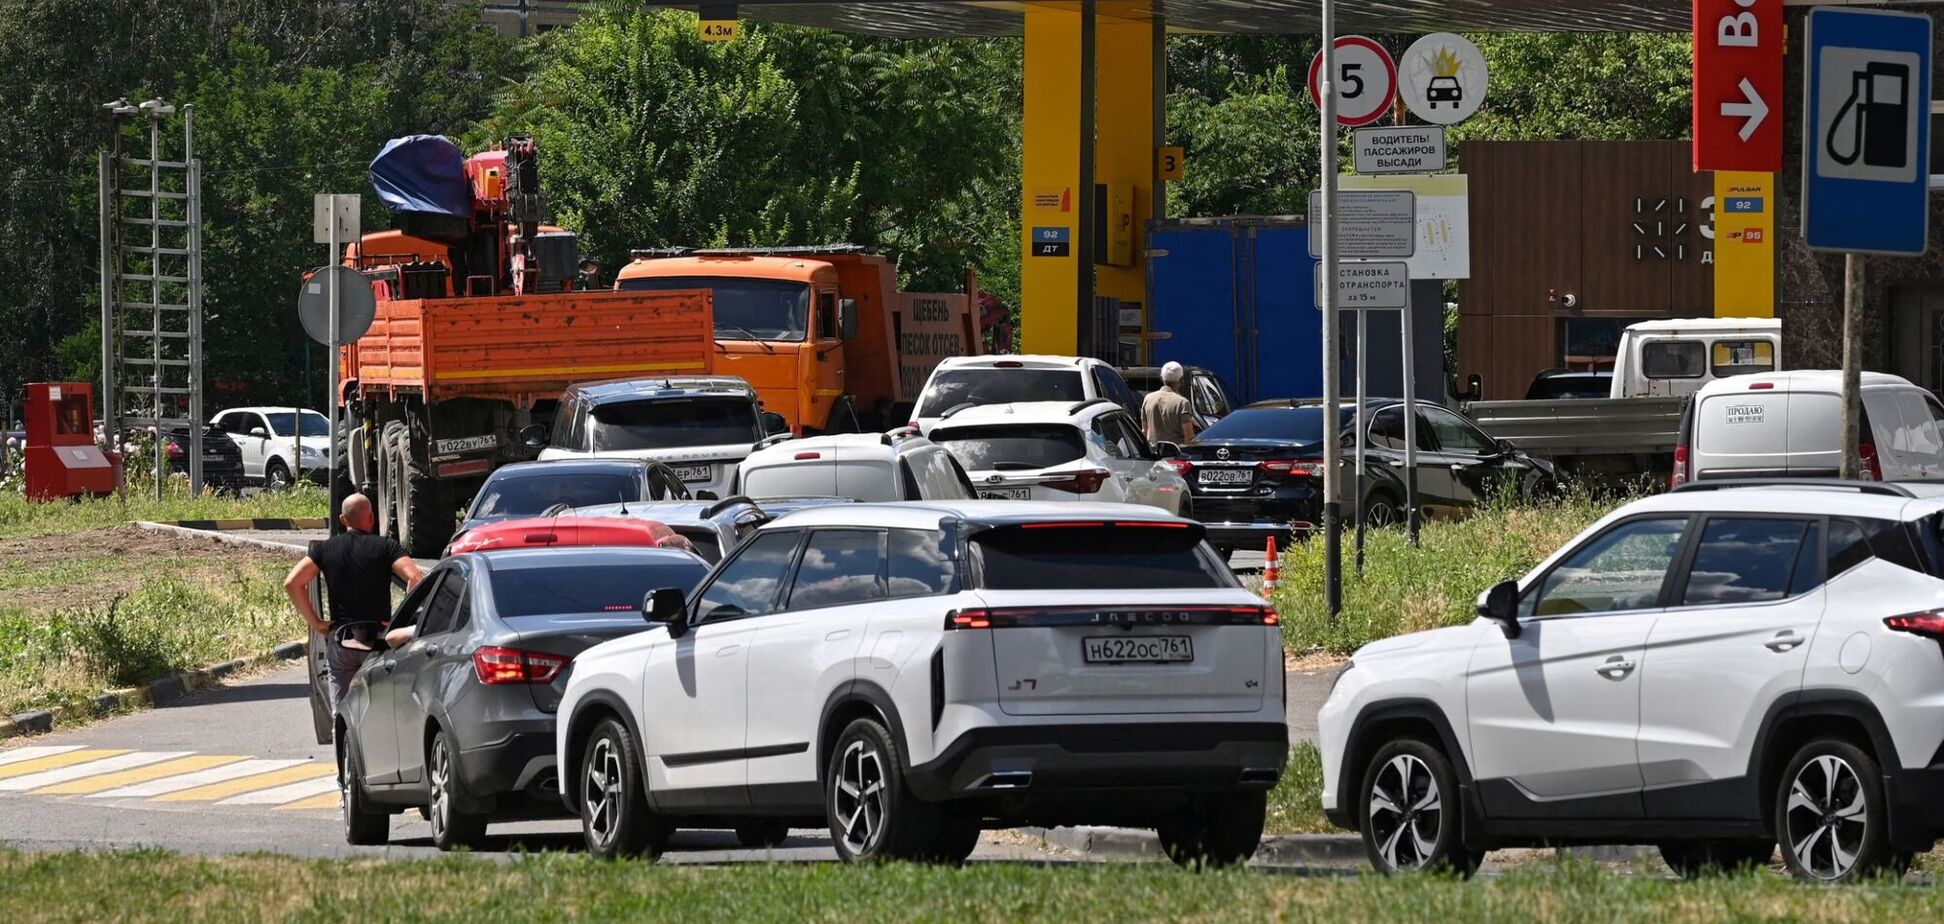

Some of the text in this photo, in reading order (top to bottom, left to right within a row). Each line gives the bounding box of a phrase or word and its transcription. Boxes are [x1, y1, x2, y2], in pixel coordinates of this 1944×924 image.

[1718, 0, 1758, 47] В
[1340, 63, 1365, 99] 5
[1371, 134, 1430, 146] ВОДИТЕЛЬ!
[1364, 145, 1436, 157] ПАССАЖИРОВ
[1164, 155, 1175, 172] 3
[1376, 157, 1422, 168] ВЫСАДИ
[1735, 201, 1752, 210] 92
[1043, 230, 1059, 239] 92
[1746, 231, 1761, 240] 95
[1042, 245, 1059, 253] ДТ
[1339, 268, 1390, 277] СТАНОВКА
[1360, 293, 1368, 301] 15
[913, 298, 949, 322] ЩЕБЕНЬ
[901, 332, 931, 356] ПЕСОК
[1728, 406, 1763, 416] ПРОДАЮ
[692, 467, 708, 476] 761
[1010, 490, 1027, 499] 761
[1090, 612, 1190, 622] JAECOO
[1090, 638, 1189, 659] Н622ОС 761
